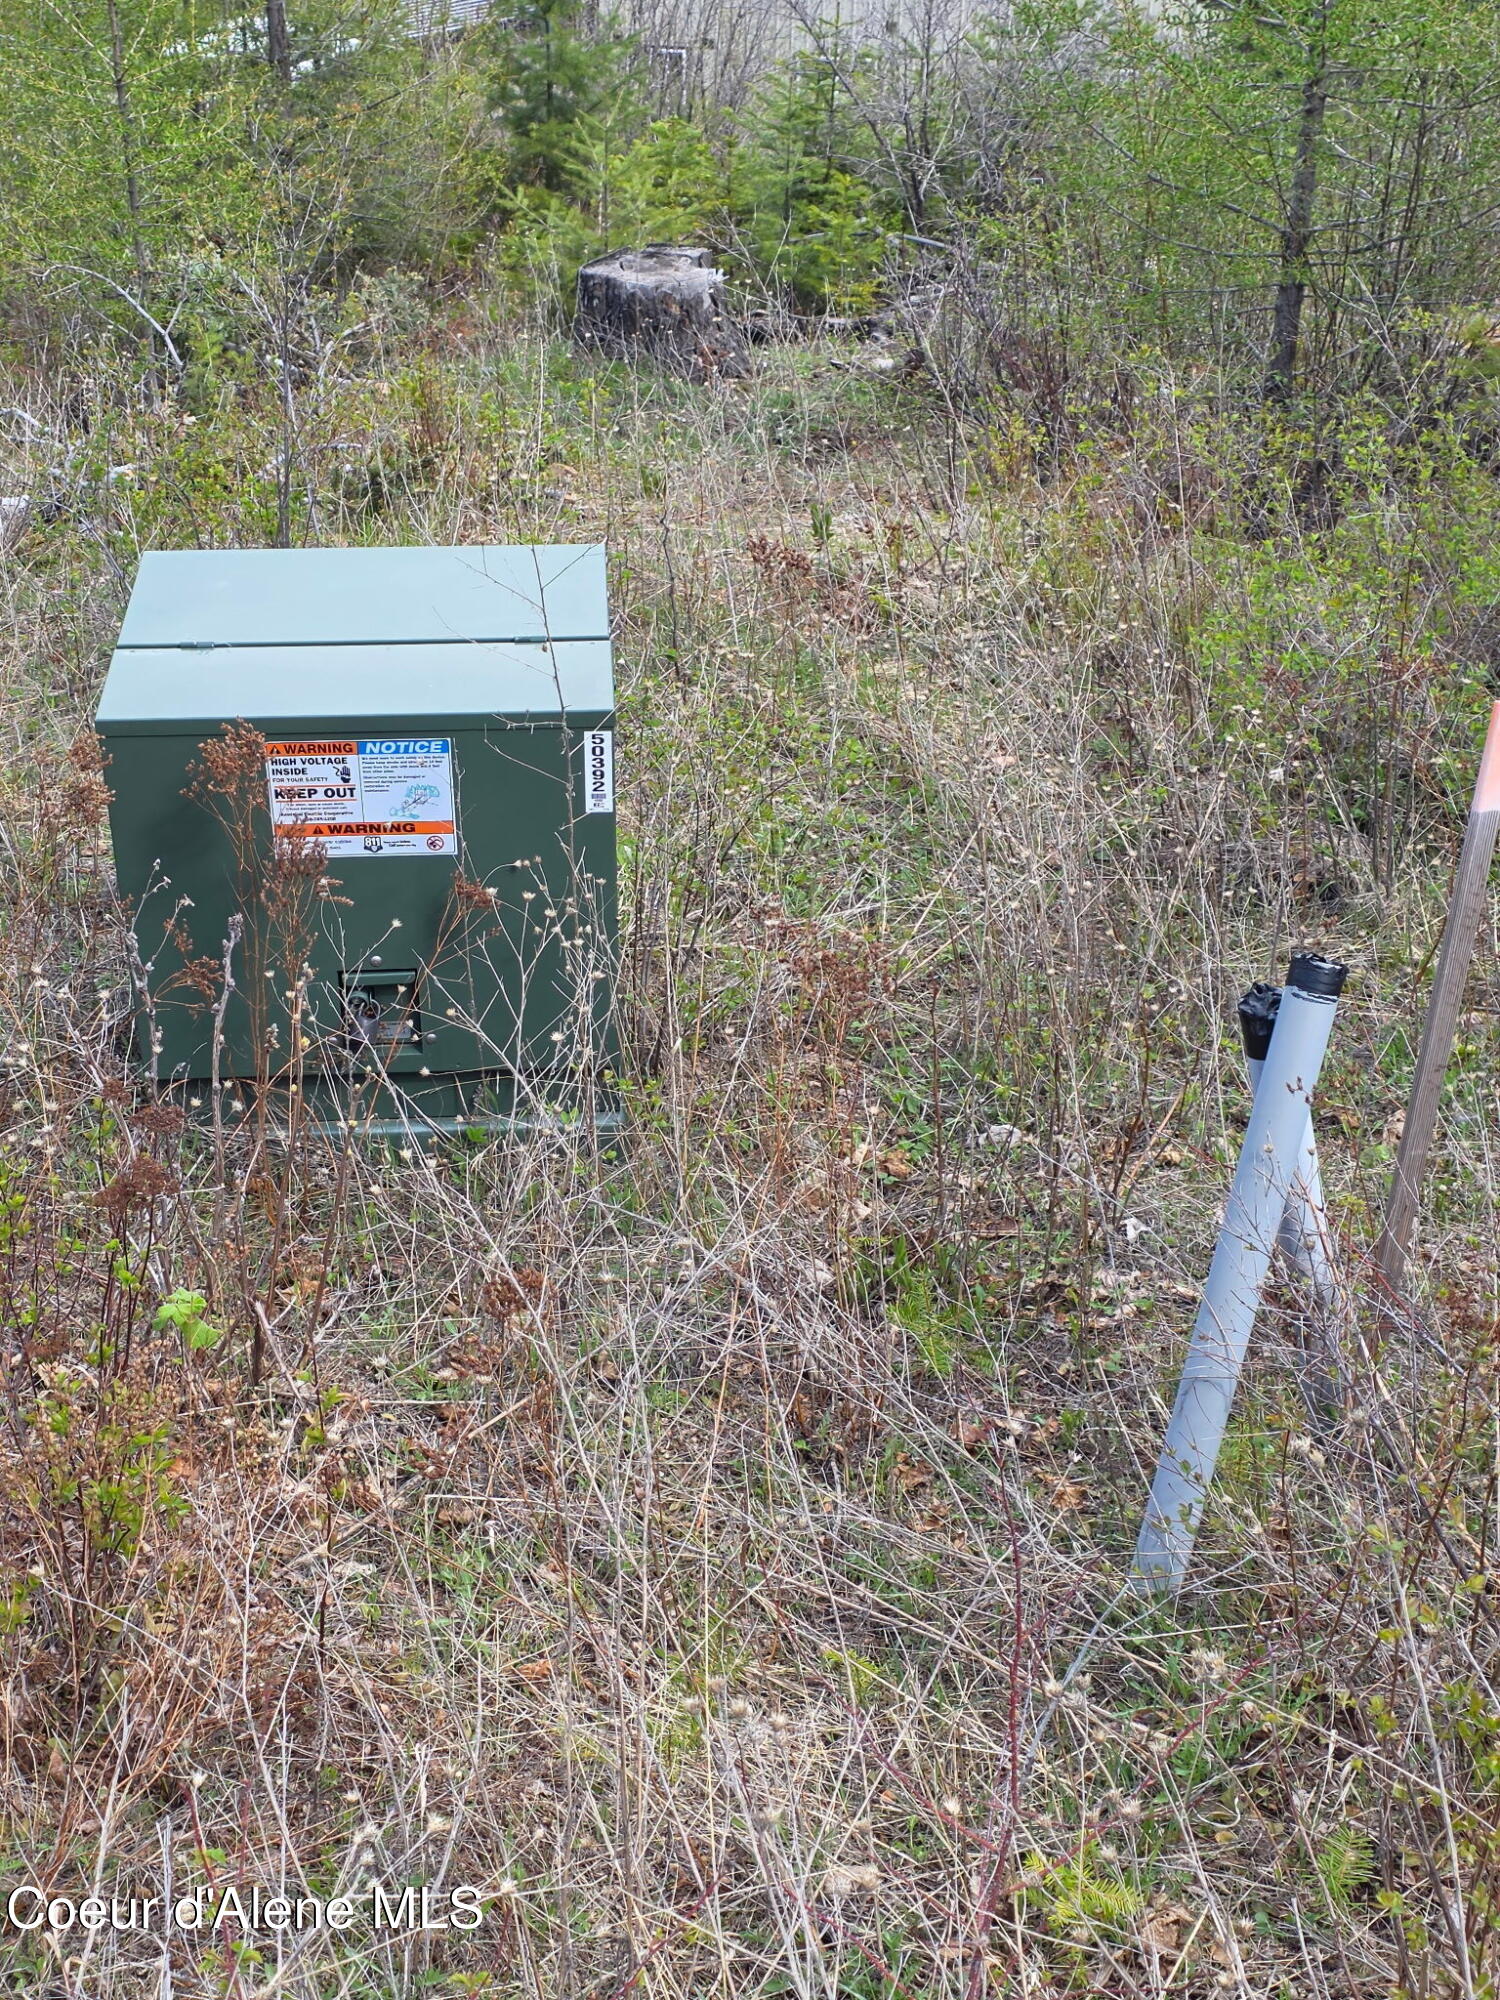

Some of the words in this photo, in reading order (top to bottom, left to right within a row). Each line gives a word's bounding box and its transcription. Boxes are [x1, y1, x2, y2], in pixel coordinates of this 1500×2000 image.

[284, 742, 353, 755] WARNING
[365, 741, 443, 754] NOTICE
[271, 758, 296, 766] HIGH
[300, 757, 348, 765] VOLTAGE
[591, 734, 605, 792] 50392
[272, 768, 308, 776] INSIDE
[324, 787, 356, 798] OUT
[327, 822, 416, 834] WARNING
[365, 837, 381, 847] 811
